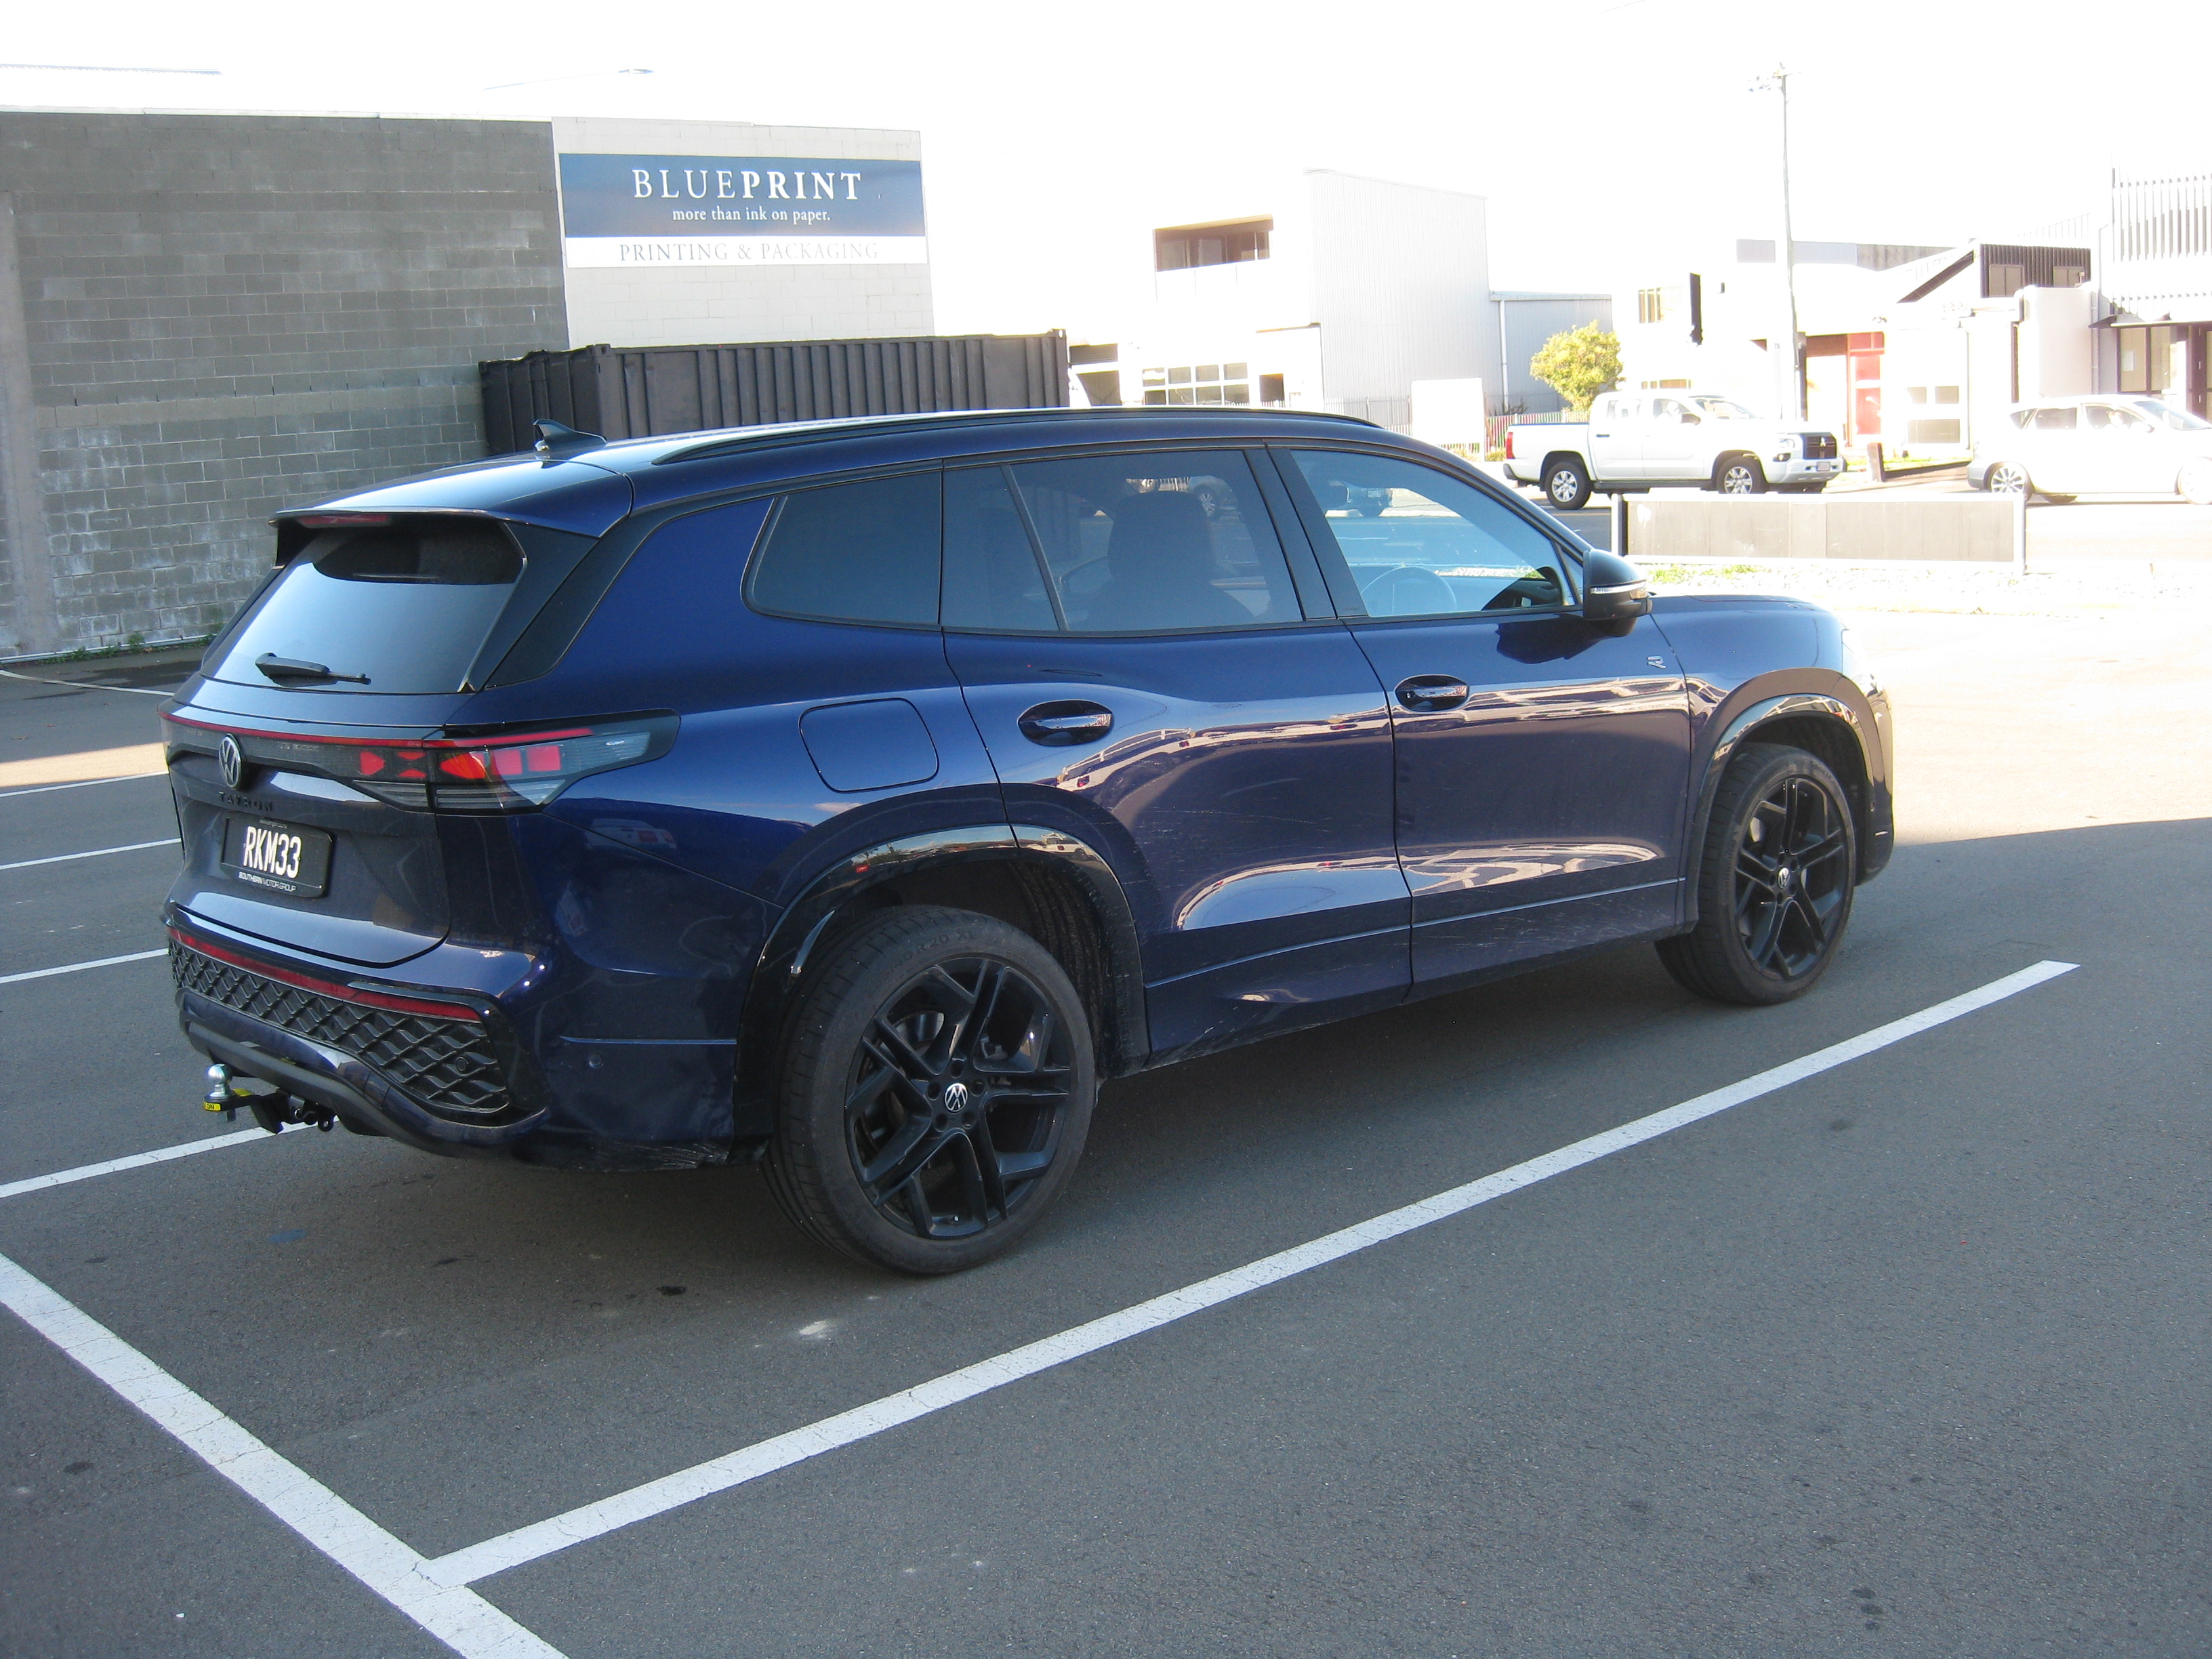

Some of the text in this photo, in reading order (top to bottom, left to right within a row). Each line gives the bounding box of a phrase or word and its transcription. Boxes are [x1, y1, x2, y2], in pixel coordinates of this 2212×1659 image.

[631, 169, 862, 201] BLUEPRINT
[672, 205, 832, 226] more than ink on paper.
[619, 242, 878, 262] PRINTING & PACKAGING
[243, 825, 302, 879] RKM33
